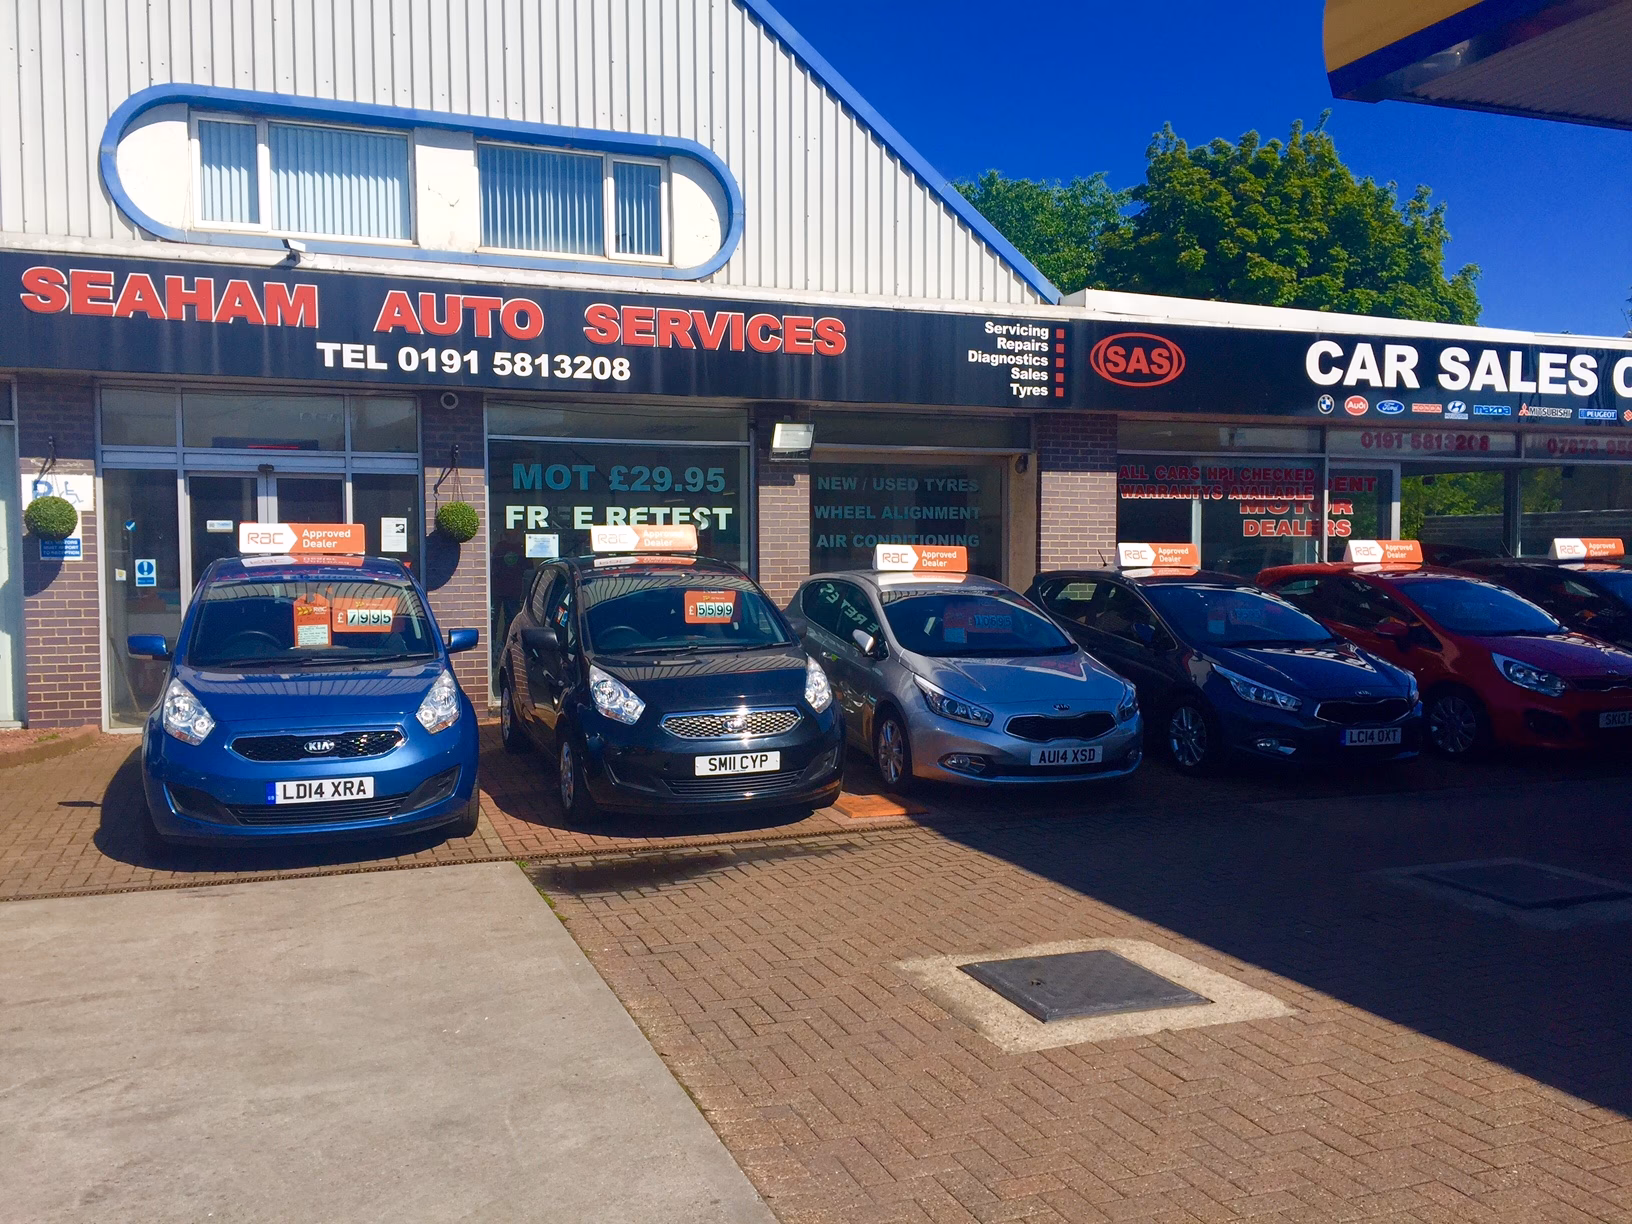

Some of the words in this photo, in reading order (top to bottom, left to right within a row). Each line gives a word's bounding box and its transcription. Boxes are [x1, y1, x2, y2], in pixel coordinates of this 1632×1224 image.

[20, 265, 319, 329] SEAHAM
[373, 290, 545, 340] AUTO
[582, 303, 848, 356] SERVICES
[984, 321, 1050, 340] Servicing
[996, 336, 1049, 353] Repairs
[316, 342, 388, 371] TEL
[398, 347, 480, 374] 0191
[492, 352, 632, 381] 5813208
[967, 349, 1049, 367] Diagnostics
[1104, 345, 1173, 376] SAS
[1010, 367, 1049, 382] Sales
[1304, 340, 1421, 389] CAR
[1437, 346, 1599, 396] SALES
[1009, 383, 1049, 399] Tyres
[1347, 400, 1366, 410] Audi
[1528, 407, 1572, 418] MITSUBISHI
[1586, 409, 1616, 418] PEUGEOT
[1360, 431, 1404, 449] 0191
[1410, 432, 1491, 452] 5813208
[512, 463, 596, 490] MOT
[608, 465, 726, 492] £29.95
[1117, 464, 1149, 481] ALL
[1155, 465, 1200, 482] CARS
[1206, 467, 1235, 483] HPI
[1240, 467, 1315, 484] CHECKED
[817, 476, 857, 490] NEW
[872, 477, 919, 491] USED
[924, 478, 980, 492] TYRES
[1120, 483, 1224, 500] WARRANTYS
[1227, 485, 1315, 501] AVAILABLE
[605, 506, 733, 530] RETEST
[814, 505, 876, 520] WHEEL
[882, 506, 981, 520] ALIGNMENT
[301, 529, 352, 539] Approved
[643, 530, 685, 540] Approved
[1242, 519, 1352, 537] DEALERS
[302, 539, 338, 549] Dealer
[644, 539, 673, 547] Dealer
[816, 534, 848, 548] AIR
[852, 534, 980, 548] CONDITIONING
[1385, 543, 1413, 553] Approved
[1588, 542, 1616, 550] Approved
[921, 550, 957, 561] Approved
[1157, 547, 1189, 557] Approved
[1159, 555, 1182, 563] Dealer
[1387, 551, 1407, 559] Dealer
[921, 559, 948, 567] Dealer
[1349, 730, 1375, 743] LC14
[308, 741, 330, 751] KIA
[708, 757, 736, 771] SM11
[740, 754, 768, 769] CYP
[1038, 750, 1068, 764] AU14
[1071, 748, 1096, 762] XSD
[282, 781, 326, 800] LD14
[331, 779, 367, 797] XRA
